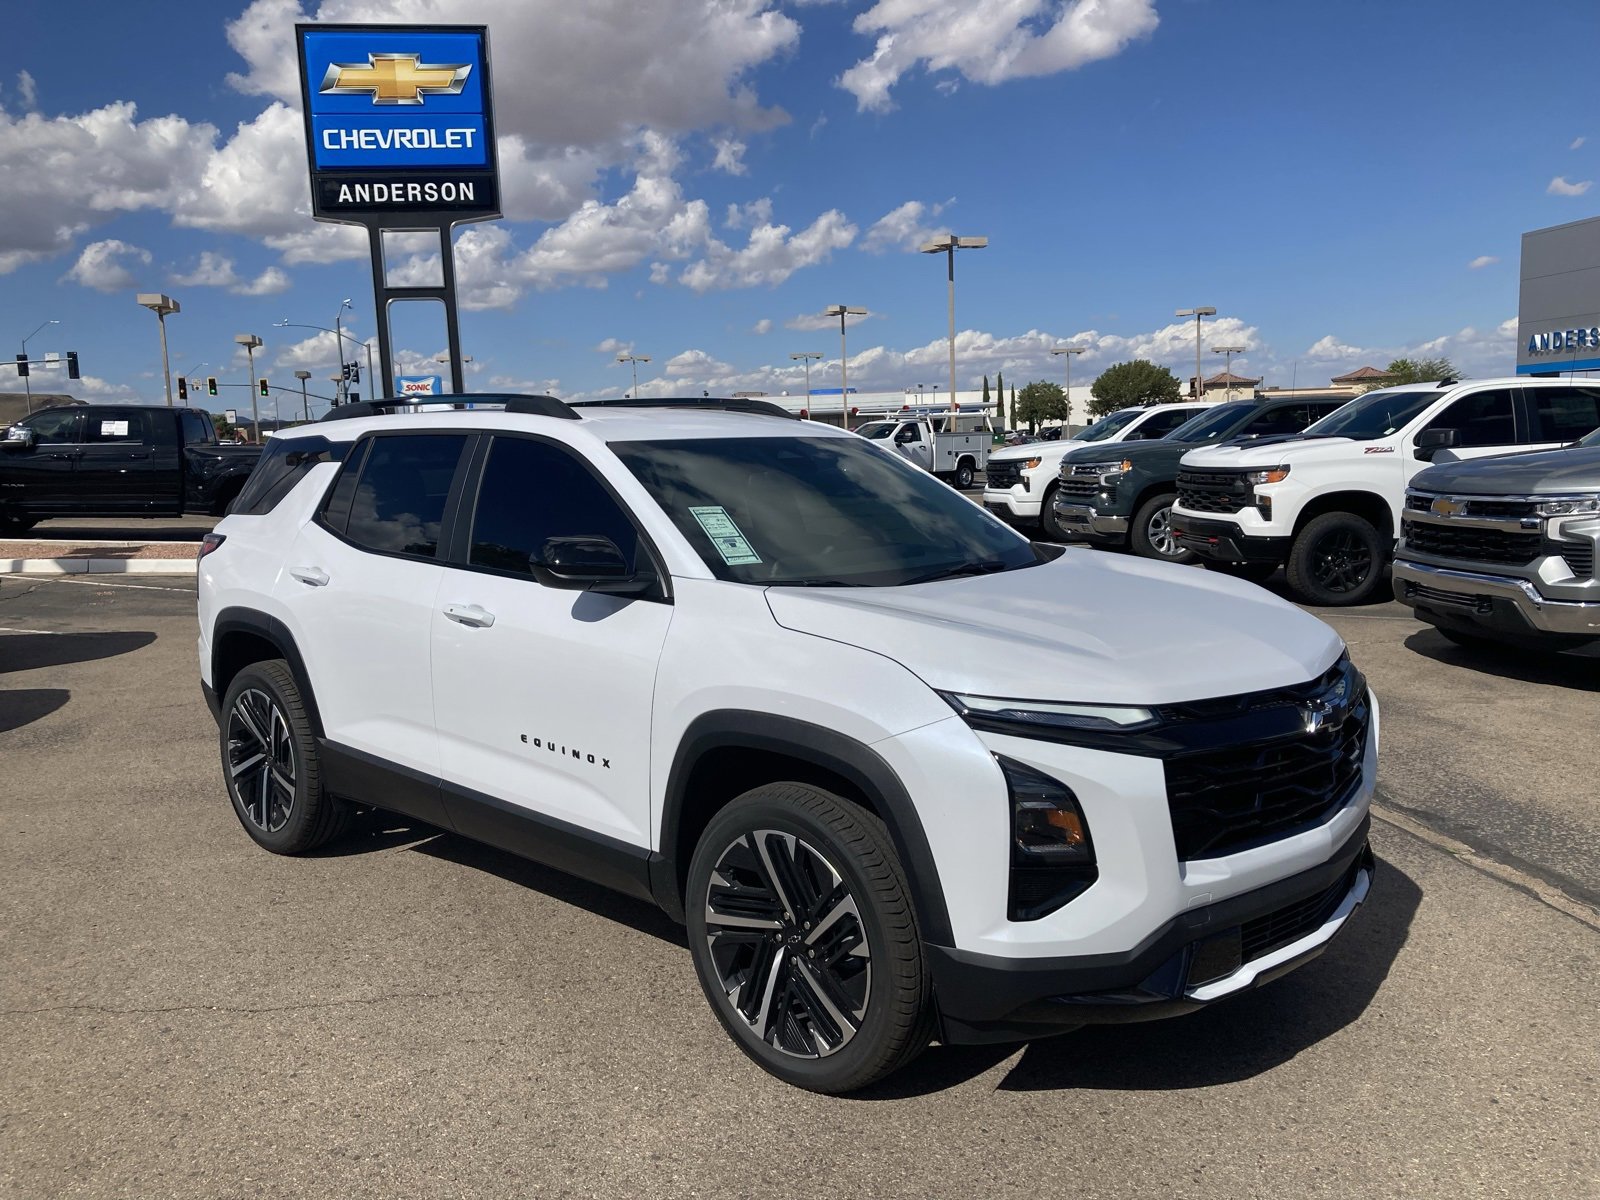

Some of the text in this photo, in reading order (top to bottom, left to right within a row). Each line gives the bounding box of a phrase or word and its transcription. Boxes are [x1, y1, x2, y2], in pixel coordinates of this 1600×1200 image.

[323, 128, 476, 150] CHEVROLET
[338, 182, 475, 203] ANDERSON
[1528, 327, 1600, 352] ANDERS
[405, 383, 431, 392] SONIC
[520, 733, 611, 769] EQUINOX
